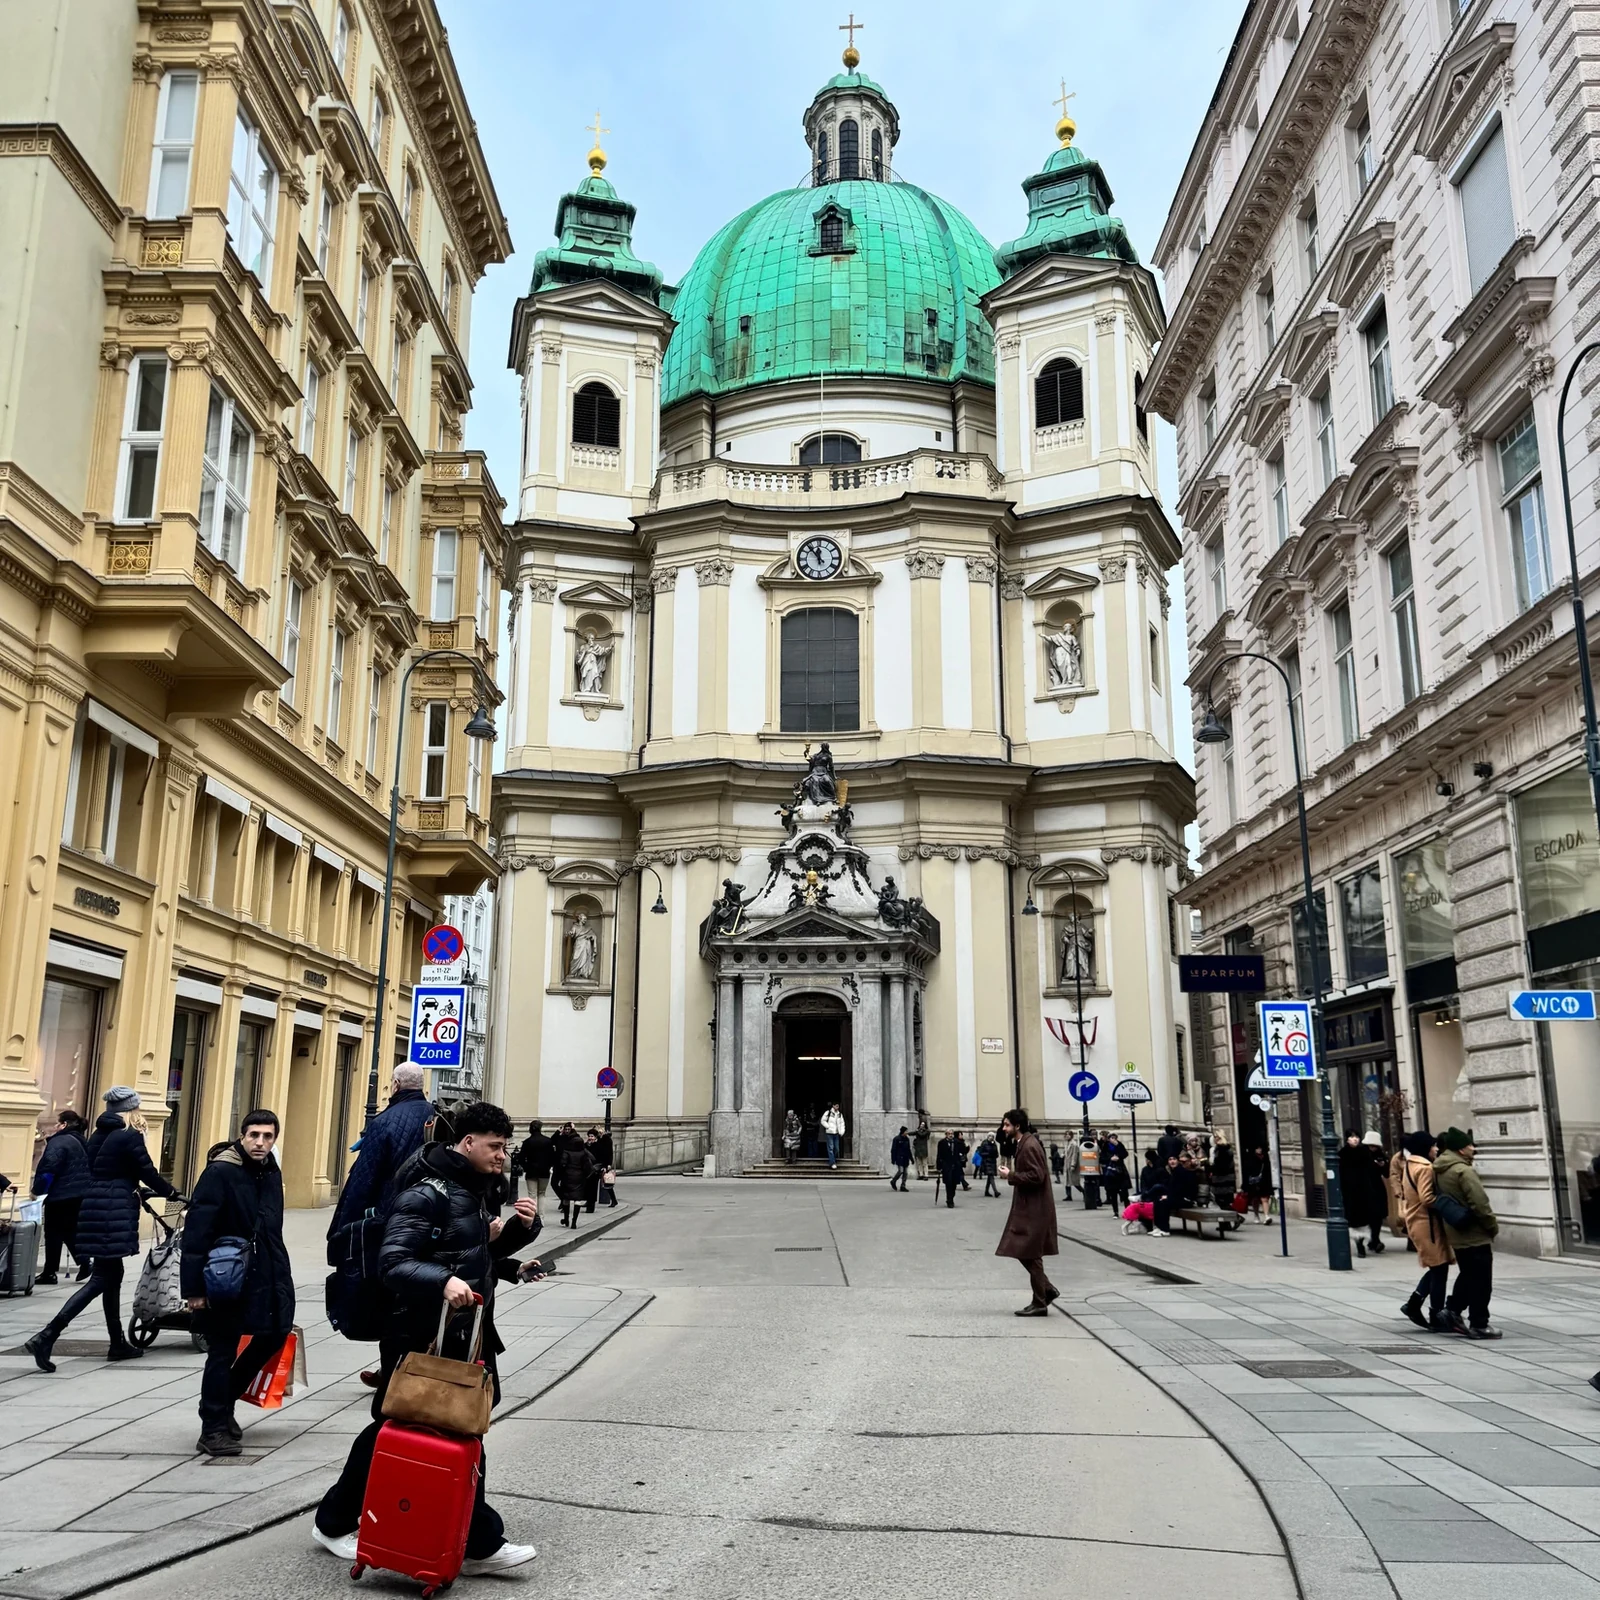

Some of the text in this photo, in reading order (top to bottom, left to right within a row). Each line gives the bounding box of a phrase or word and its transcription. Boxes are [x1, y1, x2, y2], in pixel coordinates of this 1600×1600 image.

[1534, 829, 1585, 862] ESCADA
[1410, 890, 1443, 913] ESCADA
[1201, 969, 1255, 977] PARFUM
[1532, 997, 1561, 1013] WC
[440, 1025, 456, 1040] 20
[1292, 1040, 1306, 1052] 20
[419, 1047, 452, 1059] Zone
[1275, 1059, 1306, 1071] Zone
